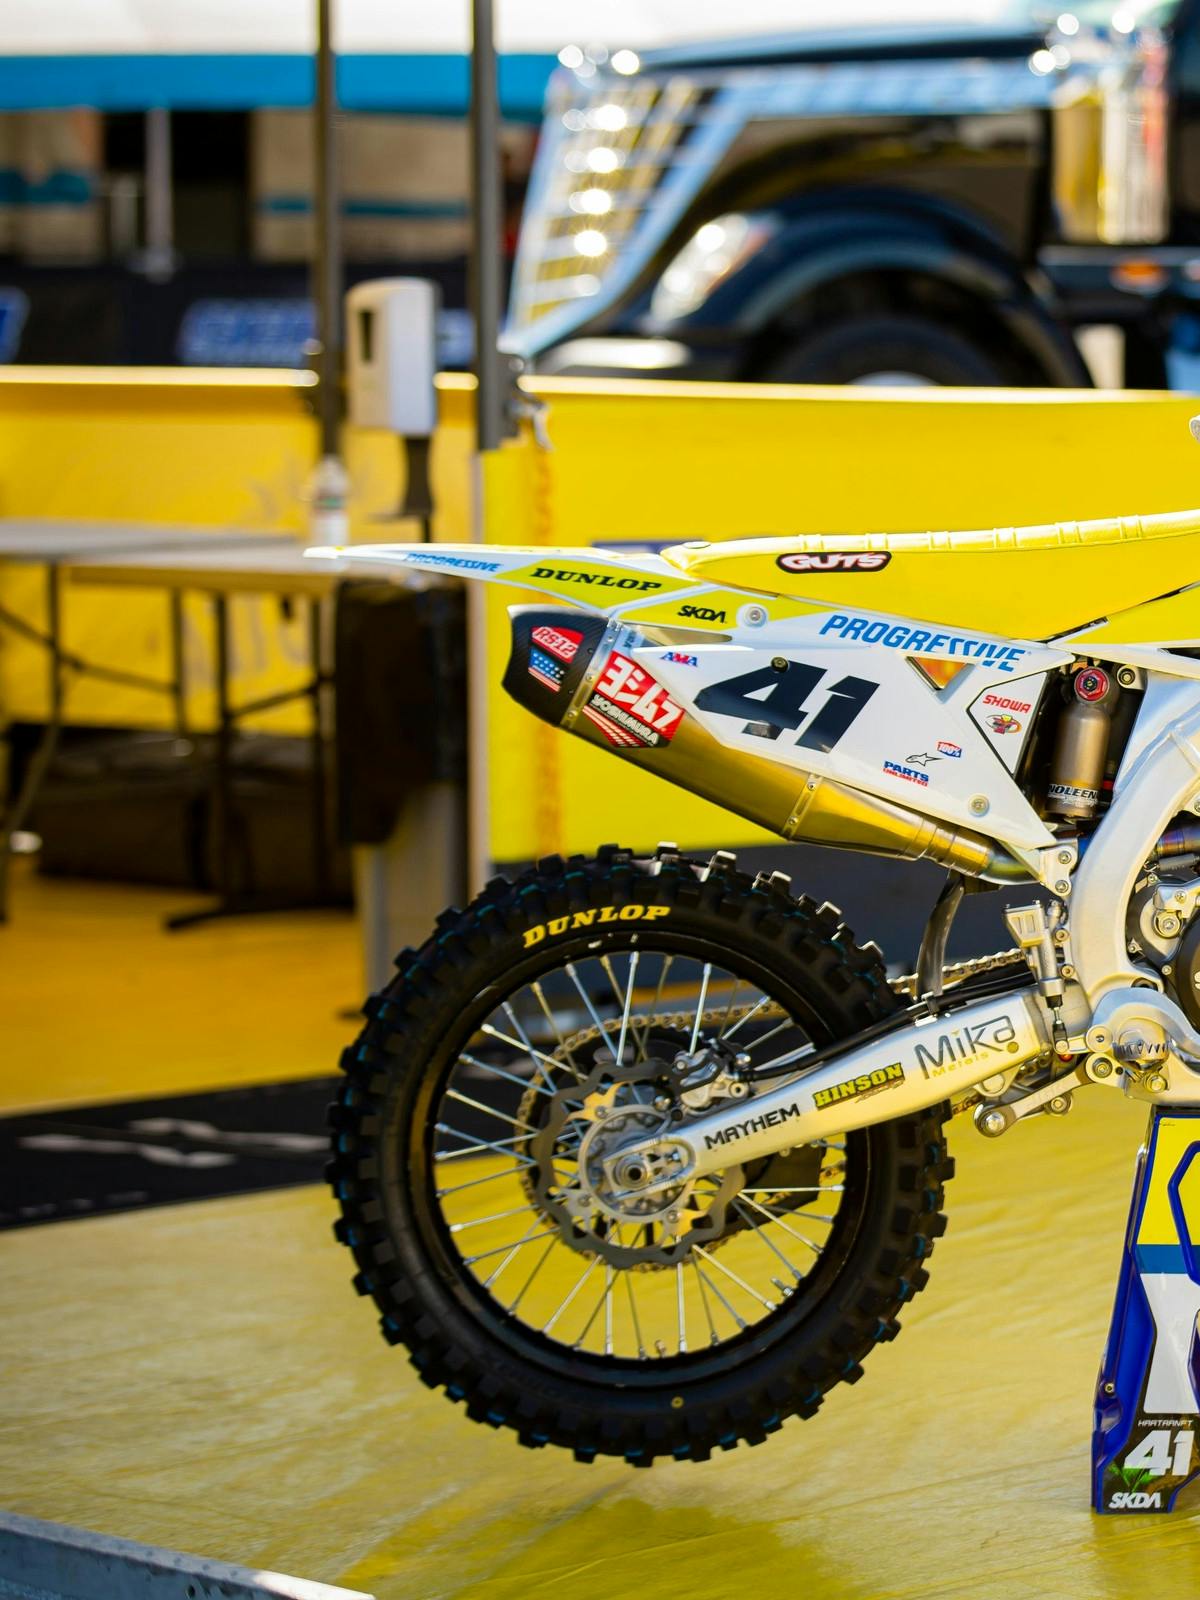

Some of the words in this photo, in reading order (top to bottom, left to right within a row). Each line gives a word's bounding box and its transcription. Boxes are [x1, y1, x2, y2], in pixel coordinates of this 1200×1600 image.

[780, 552, 889, 571] GUTS
[530, 567, 662, 593] DUNLOP
[677, 605, 727, 624] SKDA
[660, 651, 698, 667] AMA
[819, 614, 1027, 673] PROGRESSIVE
[591, 694, 659, 745] YOSHIMURA
[692, 660, 880, 754] 41
[982, 694, 1032, 713] SHOWA
[884, 760, 929, 782] PARTS
[1049, 783, 1099, 800] NOLEEN
[521, 904, 671, 948] DUNLOP
[914, 1015, 1016, 1080] Mika
[813, 1063, 904, 1109] HINSON
[704, 1103, 801, 1150] MAYHEM
[1123, 1430, 1195, 1476] 41
[1108, 1491, 1161, 1509] SKDA
